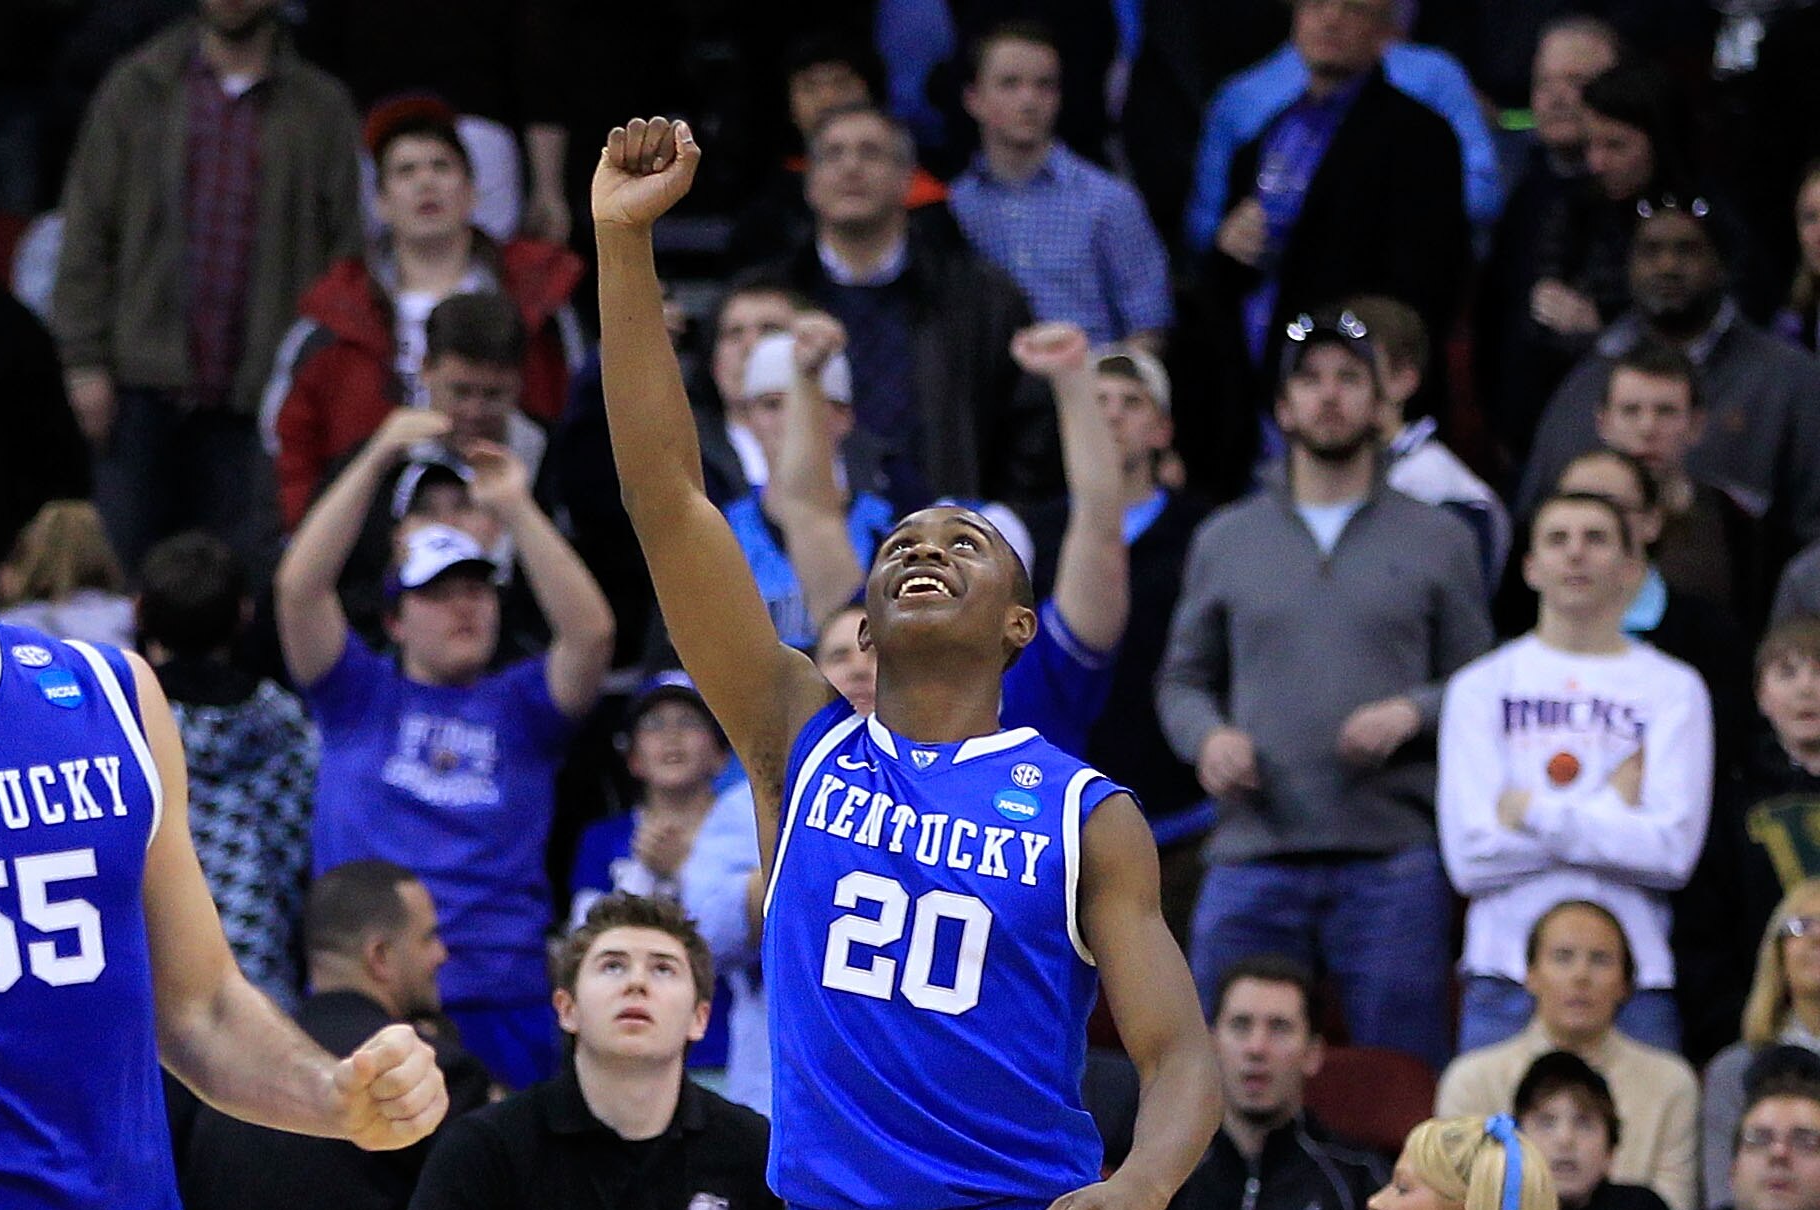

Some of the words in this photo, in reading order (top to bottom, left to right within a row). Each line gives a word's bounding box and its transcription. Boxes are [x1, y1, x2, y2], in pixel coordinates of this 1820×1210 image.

[44, 684, 81, 700] NCAA
[1013, 765, 1041, 787] SEC
[998, 799, 1036, 816] NCAA
[805, 773, 1051, 886] KENTUCKY
[821, 870, 993, 1016] 20
